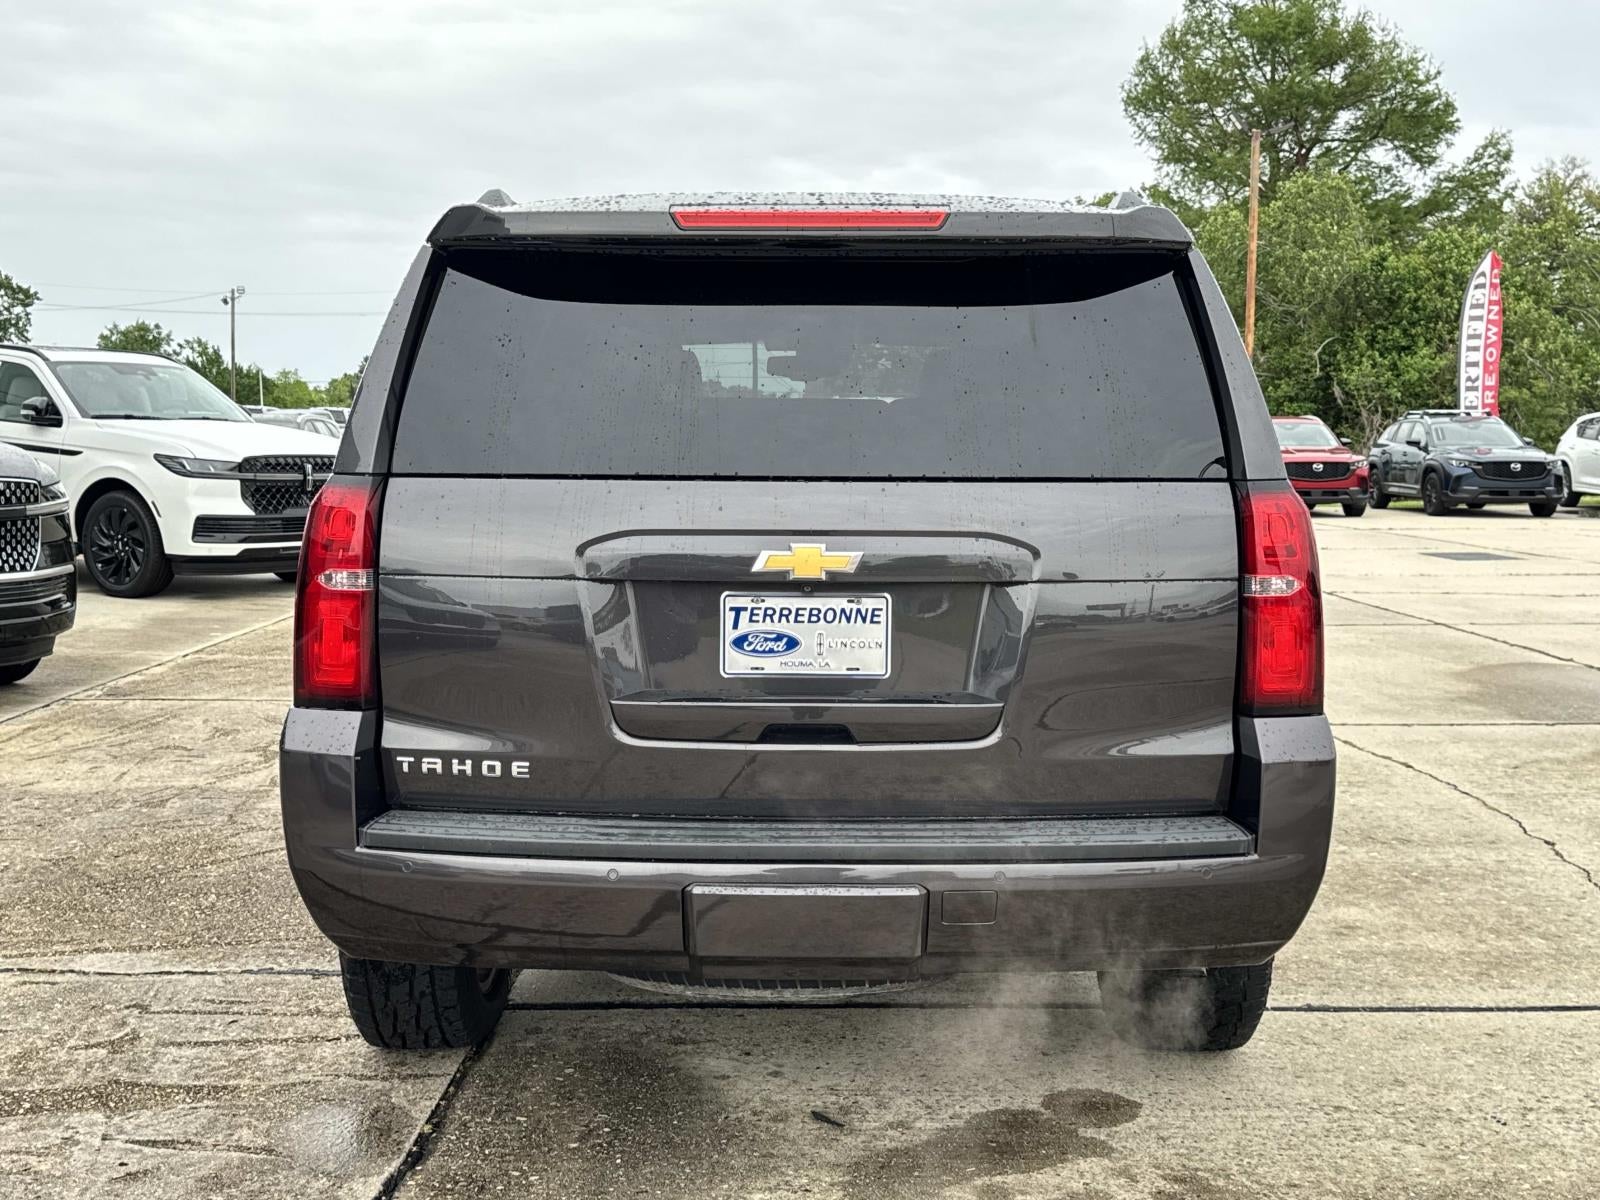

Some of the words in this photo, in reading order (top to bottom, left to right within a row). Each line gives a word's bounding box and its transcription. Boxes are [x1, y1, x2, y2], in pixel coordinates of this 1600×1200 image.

[1464, 270, 1487, 410] ERTIFIED
[1483, 268, 1501, 412] RE-OWNED
[729, 606, 883, 630] TERREBONNE
[744, 632, 787, 652] Ford
[828, 641, 883, 649] LINCOLN
[396, 756, 530, 778] TAHOE
